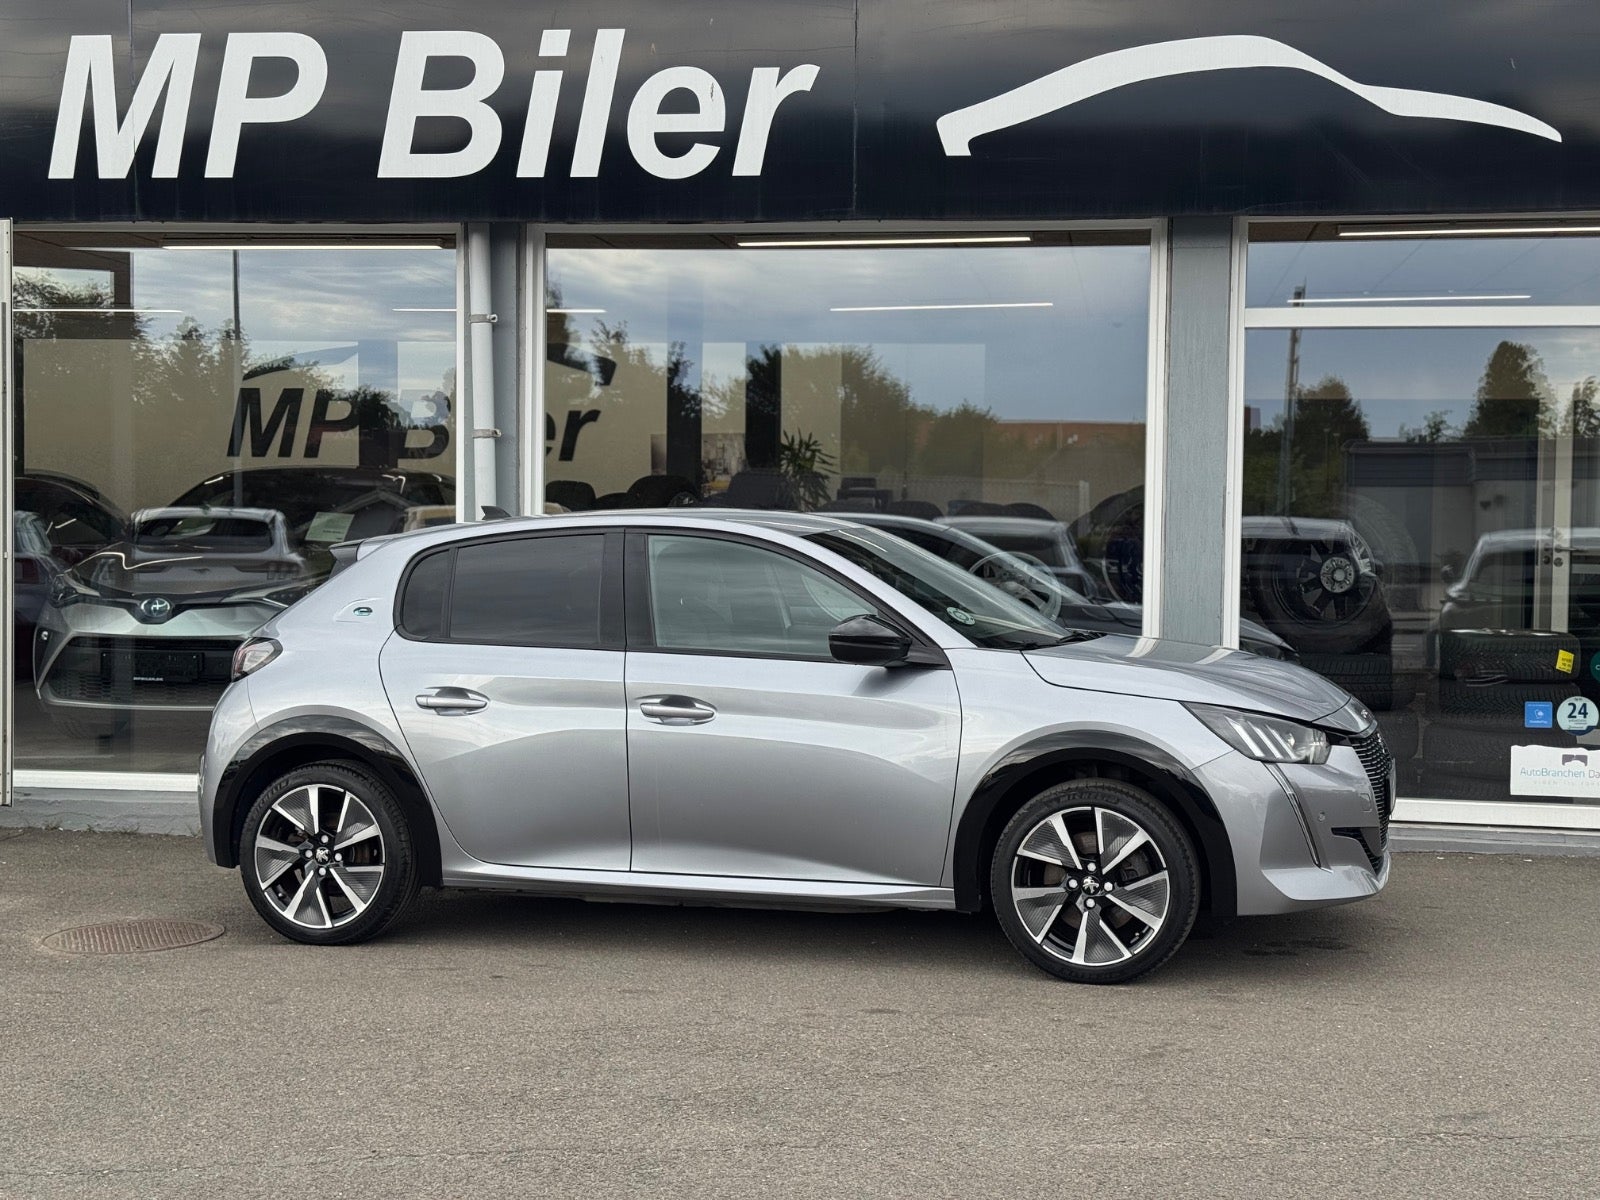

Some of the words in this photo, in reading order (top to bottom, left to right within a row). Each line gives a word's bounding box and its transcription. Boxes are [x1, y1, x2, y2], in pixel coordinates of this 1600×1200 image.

[48, 31, 327, 179] MP
[377, 28, 820, 179] Biler
[226, 388, 361, 459] MP
[1567, 702, 1588, 719] 24
[1520, 767, 1585, 778] AutoBranchen
